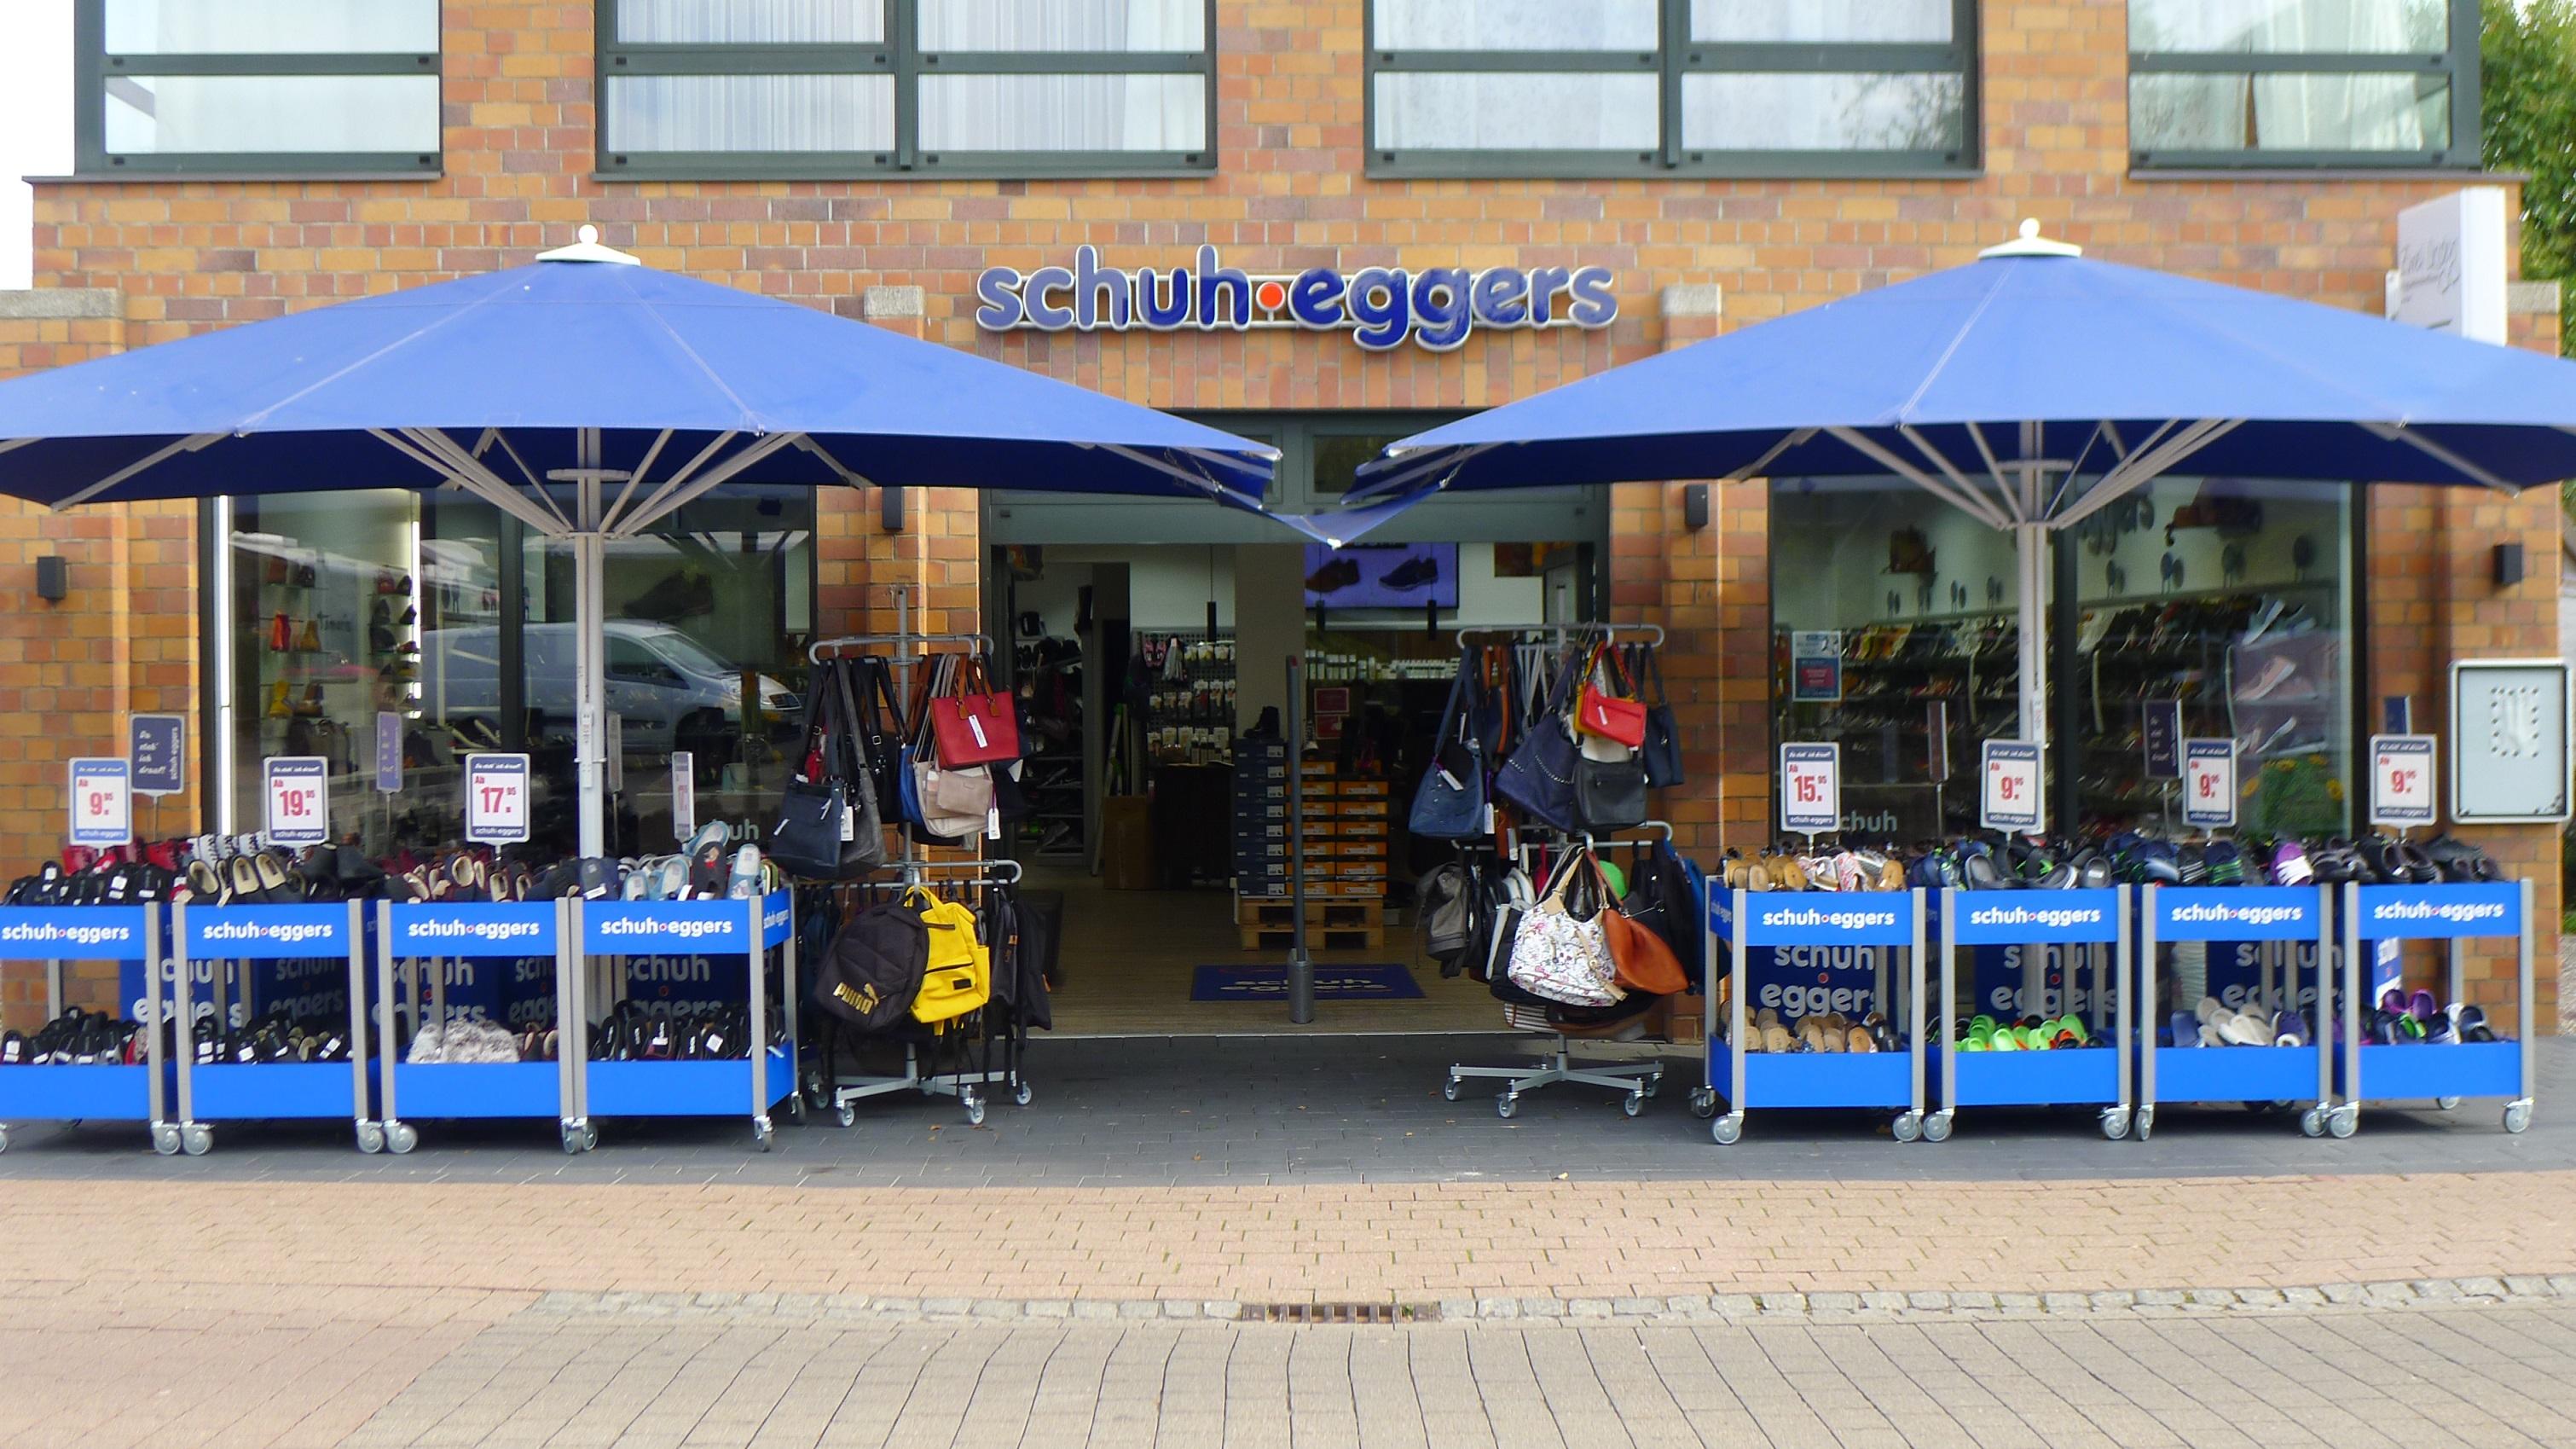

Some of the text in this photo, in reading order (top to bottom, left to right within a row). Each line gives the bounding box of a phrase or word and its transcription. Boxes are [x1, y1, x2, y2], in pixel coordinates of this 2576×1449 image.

[975, 242, 1618, 351] schuh eggers
[1840, 809, 1897, 832] chuh
[1763, 908, 1896, 929] schuh eggers
[1971, 907, 2101, 927] schuh eggers
[2171, 902, 2302, 924] schuh eggers
[2374, 900, 2504, 922] schuh eggers
[2, 923, 130, 944] schuh eggers
[203, 920, 333, 942] schuh eggers
[408, 919, 540, 940] schuh eggers
[600, 916, 732, 937] schuh eggers
[833, 982, 874, 1015] PUMA
[1759, 983, 1875, 1018] egger
